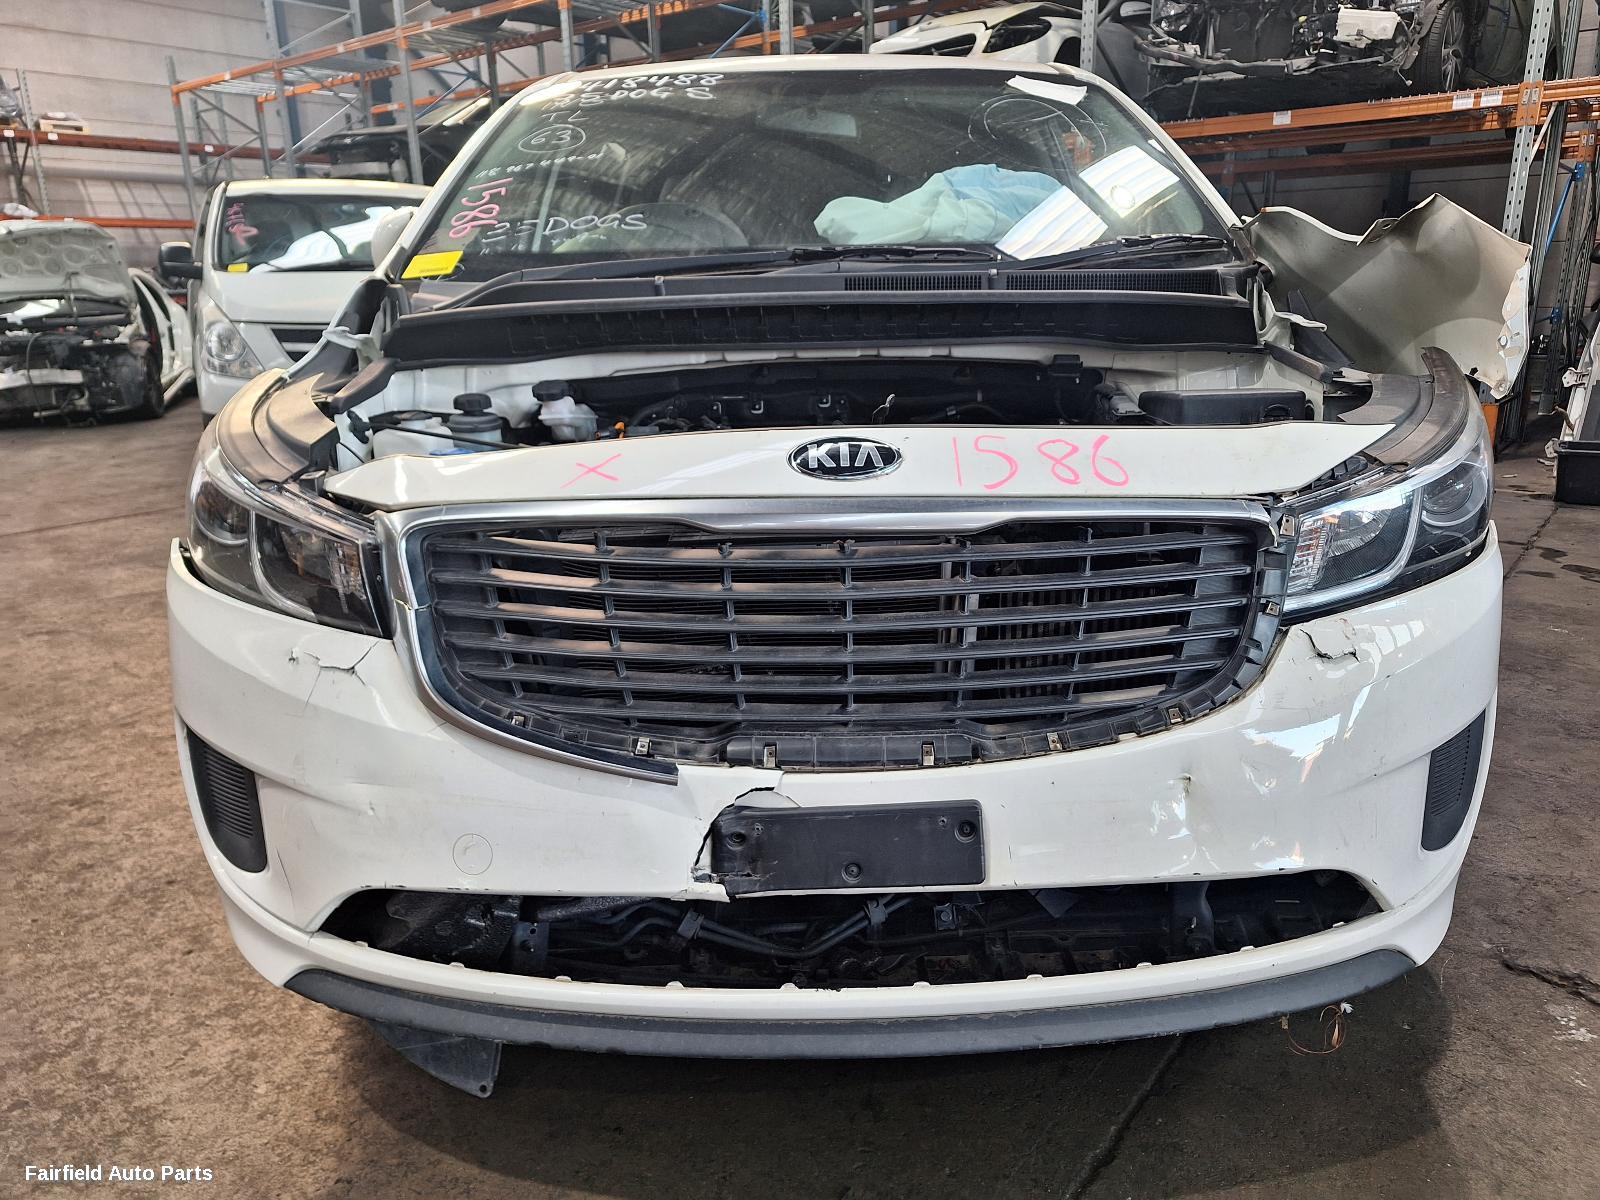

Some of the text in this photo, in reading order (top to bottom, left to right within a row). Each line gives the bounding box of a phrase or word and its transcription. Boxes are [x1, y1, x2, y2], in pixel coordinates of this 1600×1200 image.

[449, 177, 514, 239] 1586
[807, 444, 885, 468] KIA
[951, 434, 1130, 490] 1586
